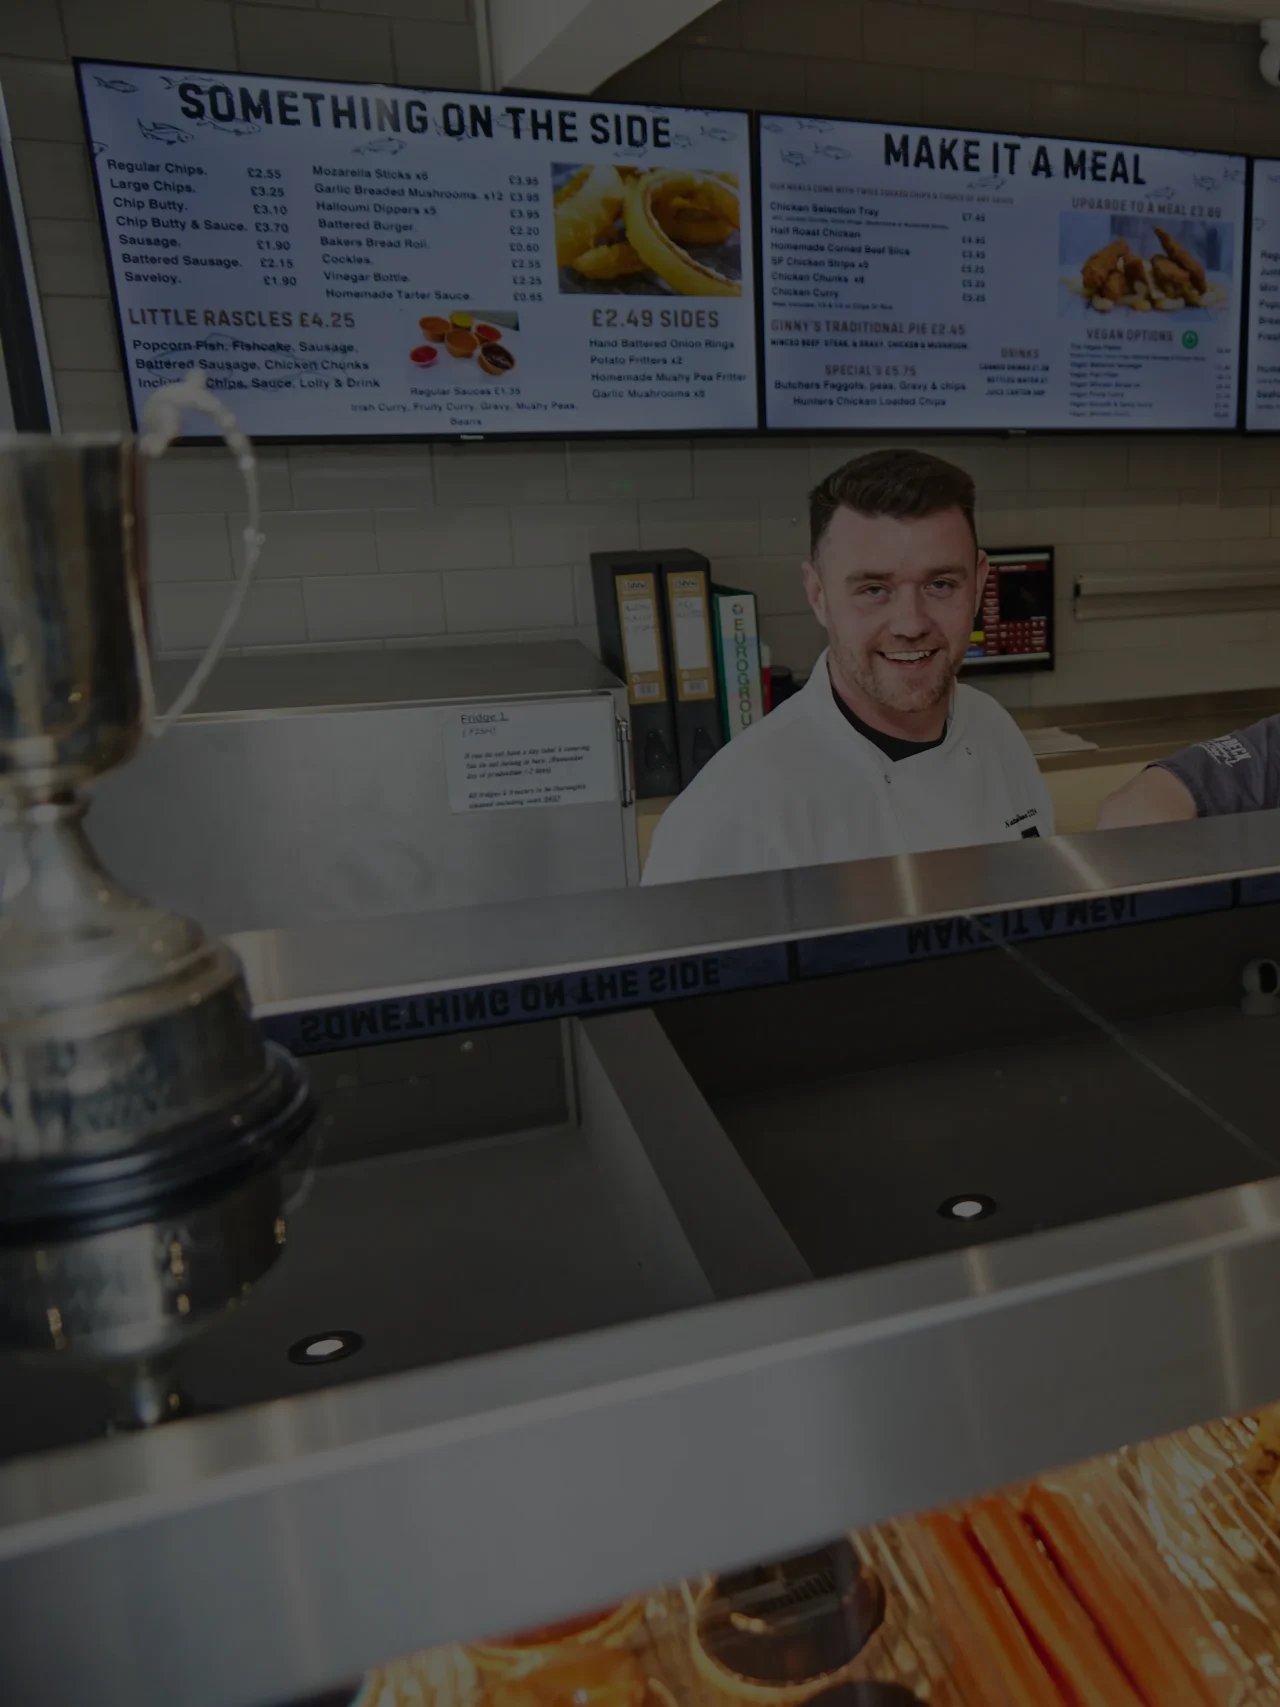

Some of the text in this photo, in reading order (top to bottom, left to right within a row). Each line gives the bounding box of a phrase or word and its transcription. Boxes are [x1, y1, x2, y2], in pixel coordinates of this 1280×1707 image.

[178, 82, 671, 148] SOMETHING ON THE SIDE
[884, 132, 1147, 185] MAKE IT A MEAL
[107, 158, 282, 180] Regular Chips. £2.55
[312, 165, 372, 180] Mozarella
[374, 168, 412, 181] Sticks
[110, 177, 285, 198] Large Chips. £3.25
[314, 183, 351, 196] Garlic
[354, 185, 405, 198] Breaded
[113, 196, 288, 216] Chip Butty. £3.10
[316, 200, 370, 214] Halloumi
[373, 202, 420, 216] Dippers
[770, 201, 880, 218] Chicken Selection Tray
[116, 215, 289, 233] Chip Butty & Sauce. £3.70
[318, 217, 370, 231] Battered
[118, 234, 291, 252] Sausage. £1.90
[320, 235, 363, 248] Bakers
[366, 237, 402, 249] Bread
[122, 253, 295, 270] Battered Sausage. £2.15
[124, 271, 297, 287] Saveloy. £1.90
[323, 271, 370, 285] Vinegar
[325, 288, 394, 300] Homemade
[128, 307, 356, 329] LITTLE RASCLES £4.25
[592, 308, 720, 329] £2.49 SIDES
[824, 320, 905, 335] TRADITIONAL
[908, 322, 928, 335] PIE
[132, 339, 192, 353] Popcorn
[589, 338, 735, 352] Hand Battered Onion Rings
[135, 358, 195, 371] Battered
[264, 359, 318, 371] Chicken
[321, 359, 369, 371] Chunks
[590, 354, 626, 367] Potato
[629, 355, 668, 367] Fritters
[299, 378, 330, 391] Lolly
[334, 379, 343, 390] &
[346, 376, 381, 389] Drink
[590, 371, 653, 383] Homemade
[655, 371, 691, 385] Mushy
[693, 371, 714, 383] Pea
[410, 385, 451, 398] Regular
[453, 386, 491, 397] Sauces
[592, 388, 690, 400] Garlic Mushrooms
[733, 618, 752, 730] EUROGROU
